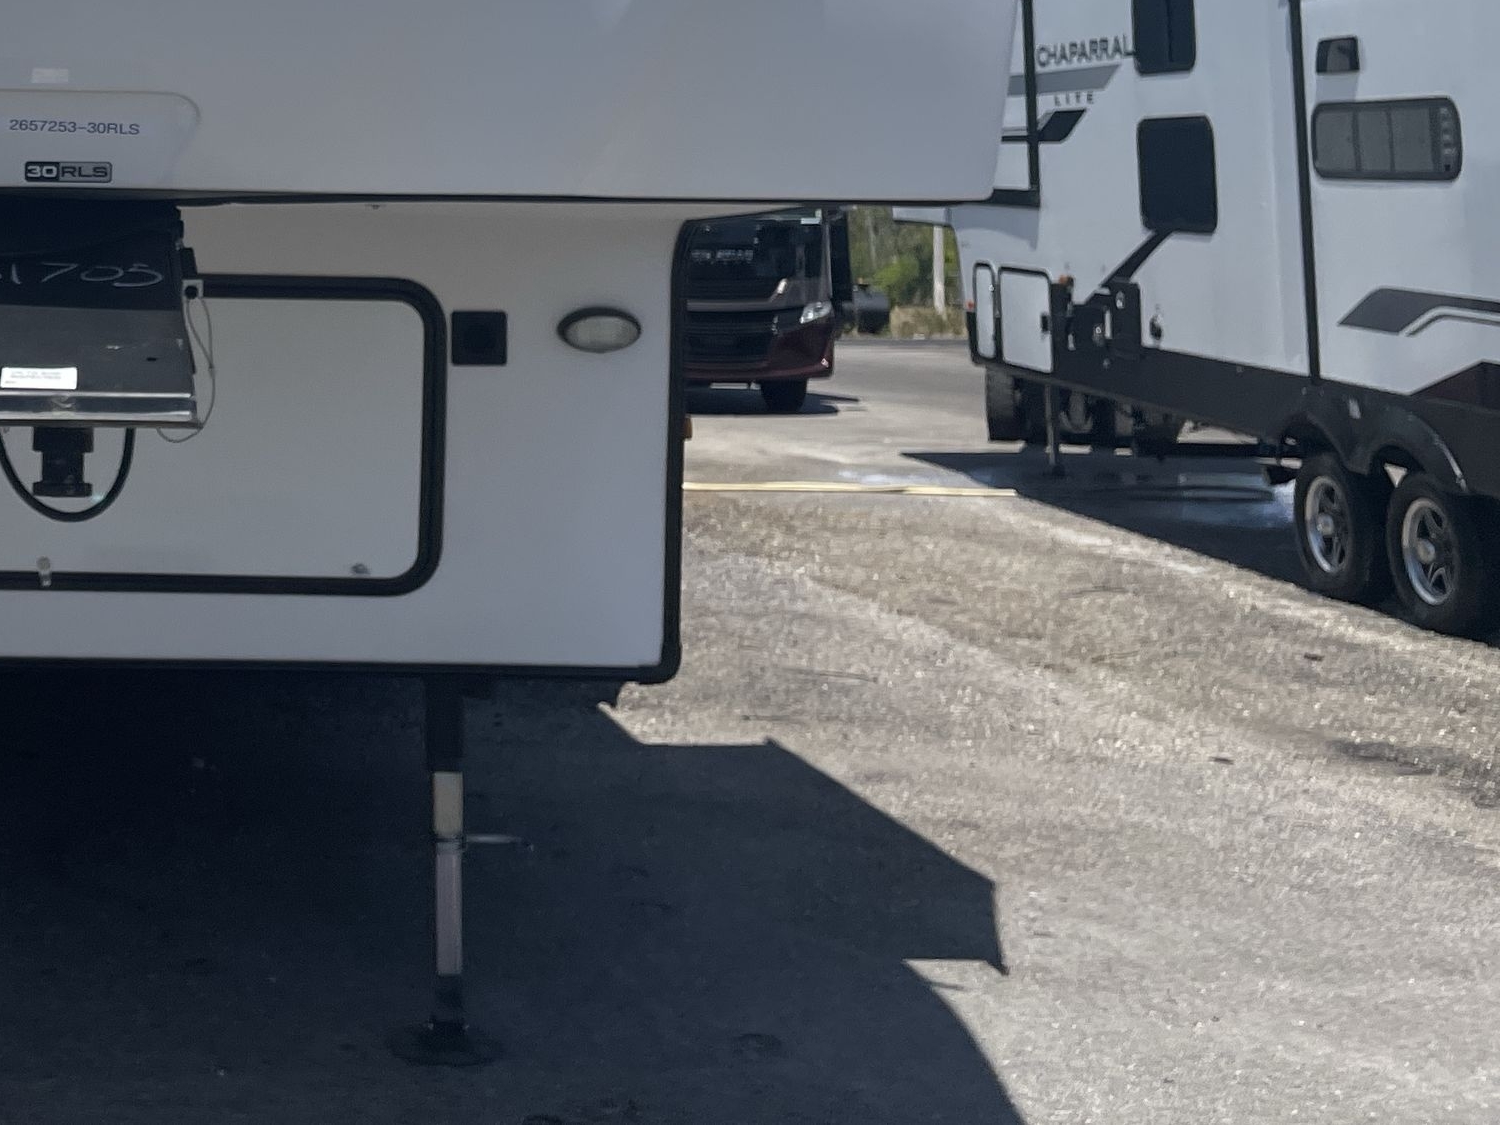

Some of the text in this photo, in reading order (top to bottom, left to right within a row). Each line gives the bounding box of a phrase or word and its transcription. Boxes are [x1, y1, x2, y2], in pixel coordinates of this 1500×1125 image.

[1037, 35, 1134, 67] CHAPARRAL
[1054, 91, 1094, 106] LITE
[9, 119, 140, 135] 2657253-30RLS
[26, 165, 108, 178] 30RLS
